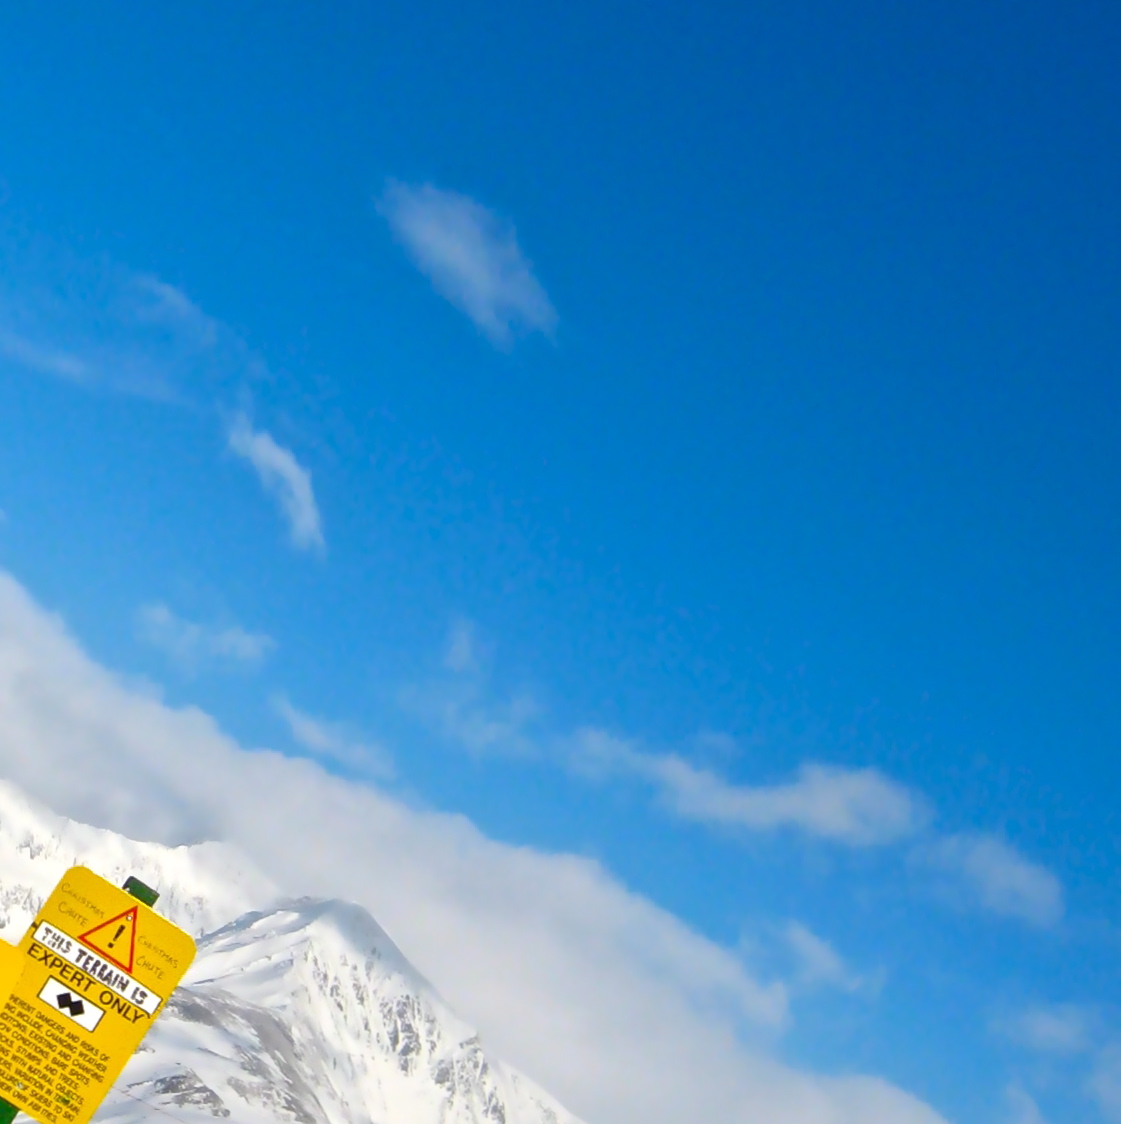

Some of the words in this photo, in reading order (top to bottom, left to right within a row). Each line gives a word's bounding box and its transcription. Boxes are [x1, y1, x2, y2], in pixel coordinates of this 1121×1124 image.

[26, 942, 97, 993] EXPERT
[98, 990, 146, 1025] ONLY
[41, 926, 73, 954] THIS
[69, 947, 130, 993] TERRAIN
[130, 986, 149, 1005] IS
